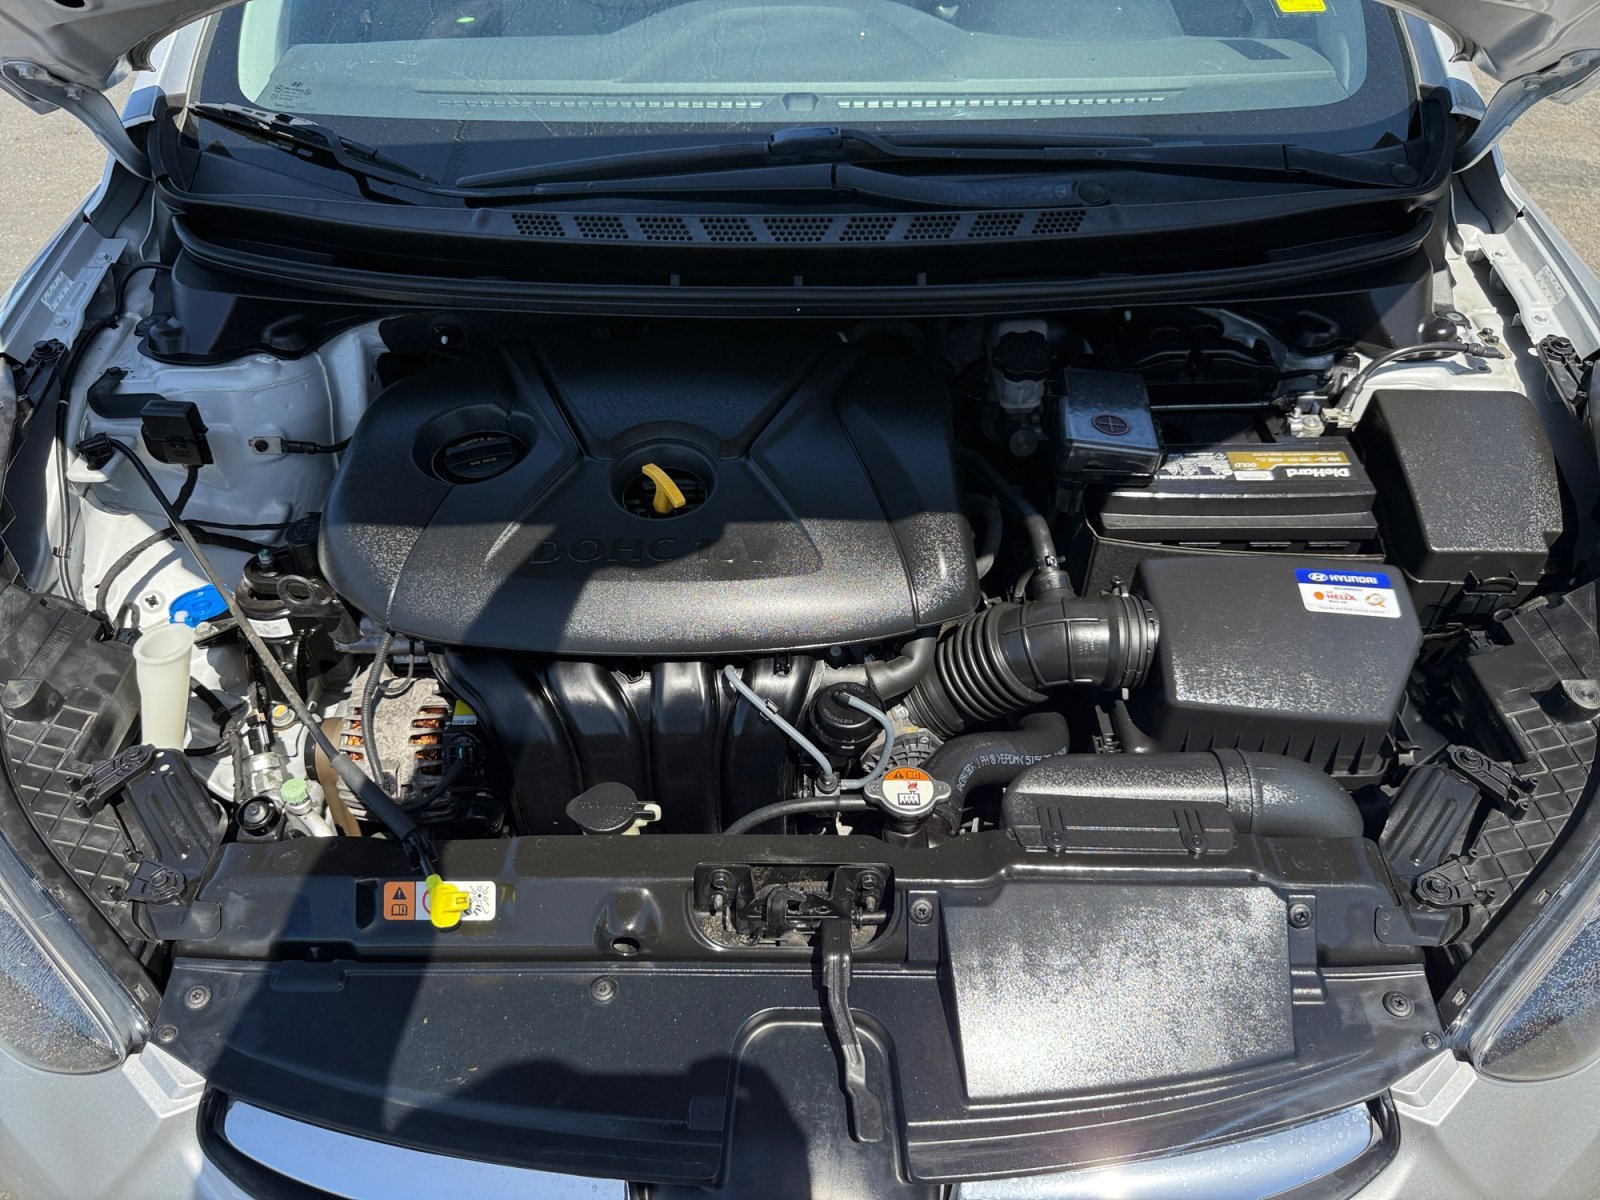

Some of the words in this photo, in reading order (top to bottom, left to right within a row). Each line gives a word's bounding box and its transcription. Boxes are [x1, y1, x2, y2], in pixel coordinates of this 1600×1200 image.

[1286, 467, 1351, 478] DieHard
[530, 536, 677, 564] DOHC
[1329, 573, 1378, 585] HYUNDAI
[1325, 591, 1357, 602] HELIX
